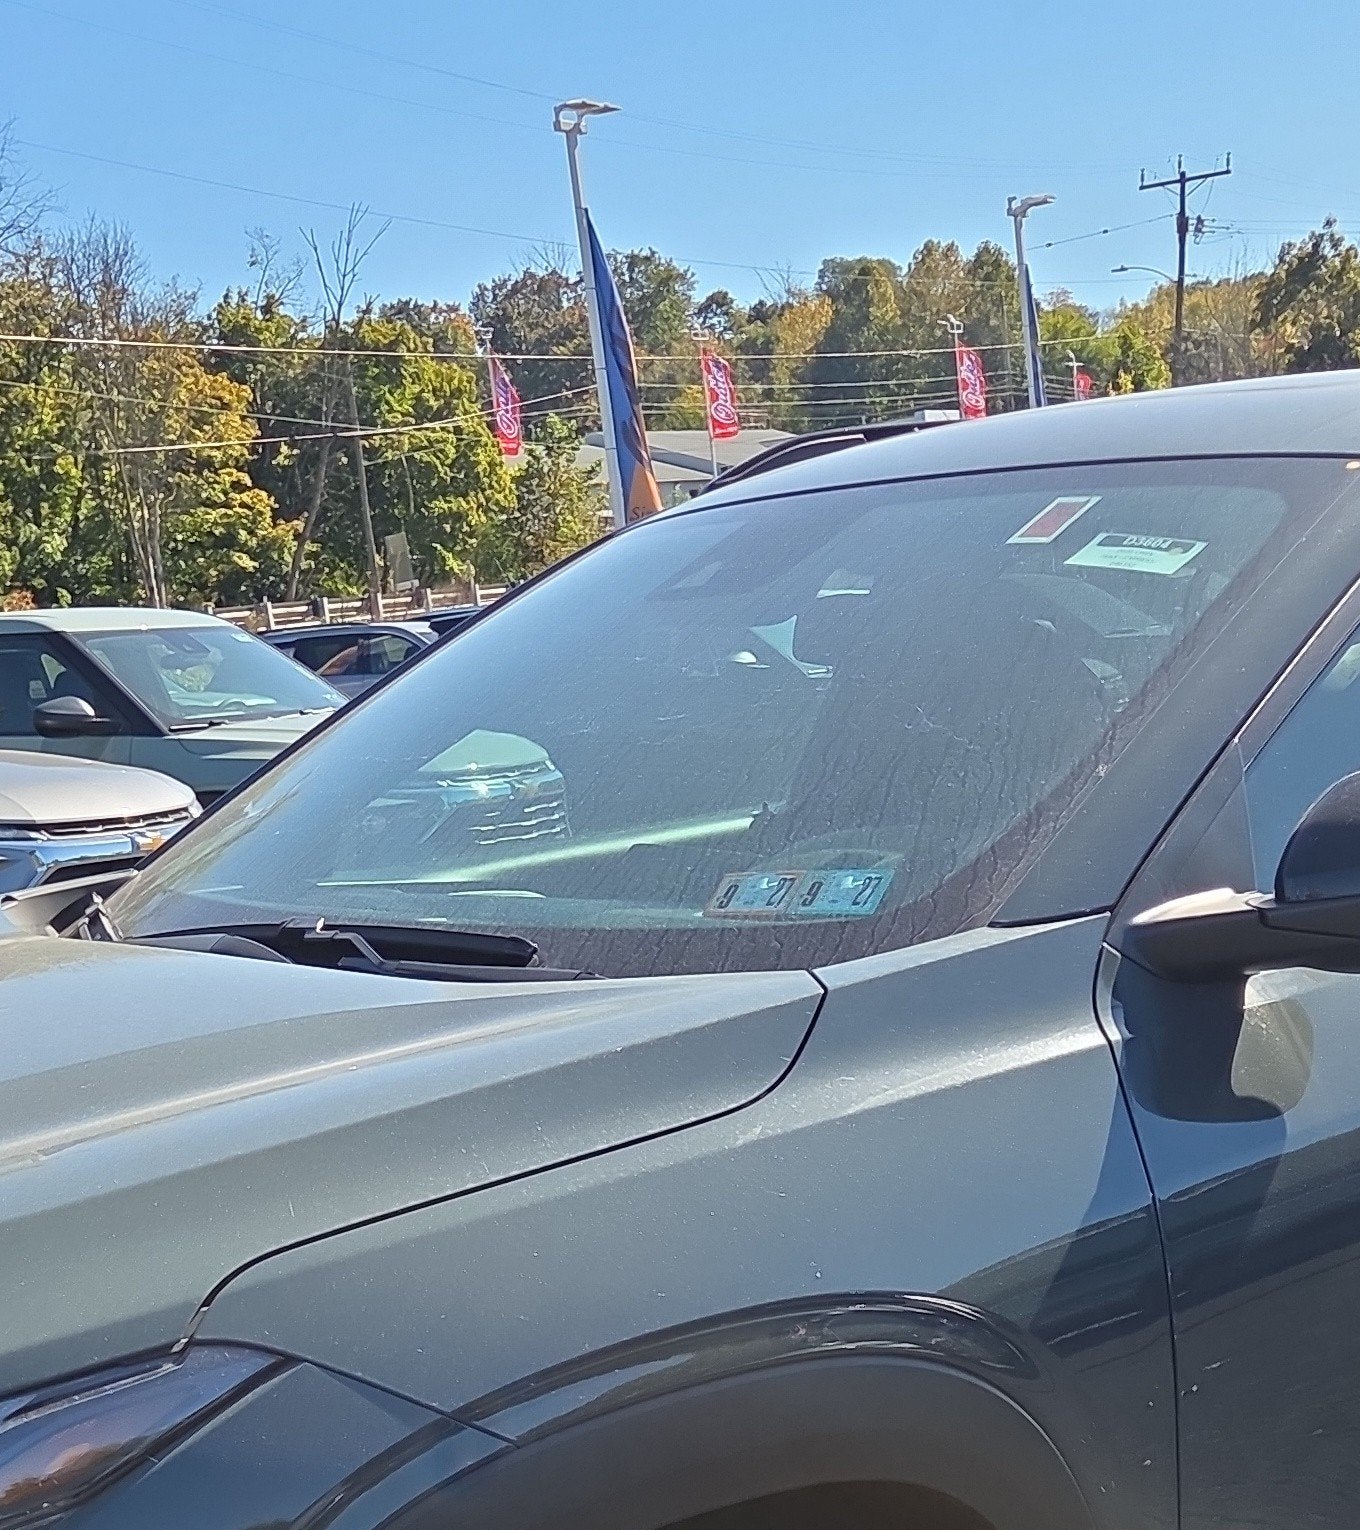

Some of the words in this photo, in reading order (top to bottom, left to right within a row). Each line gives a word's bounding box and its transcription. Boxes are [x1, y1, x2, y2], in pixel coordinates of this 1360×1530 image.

[716, 884, 740, 909] 9
[766, 877, 797, 908] 27
[801, 881, 824, 907] 9
[852, 876, 883, 907] 27
